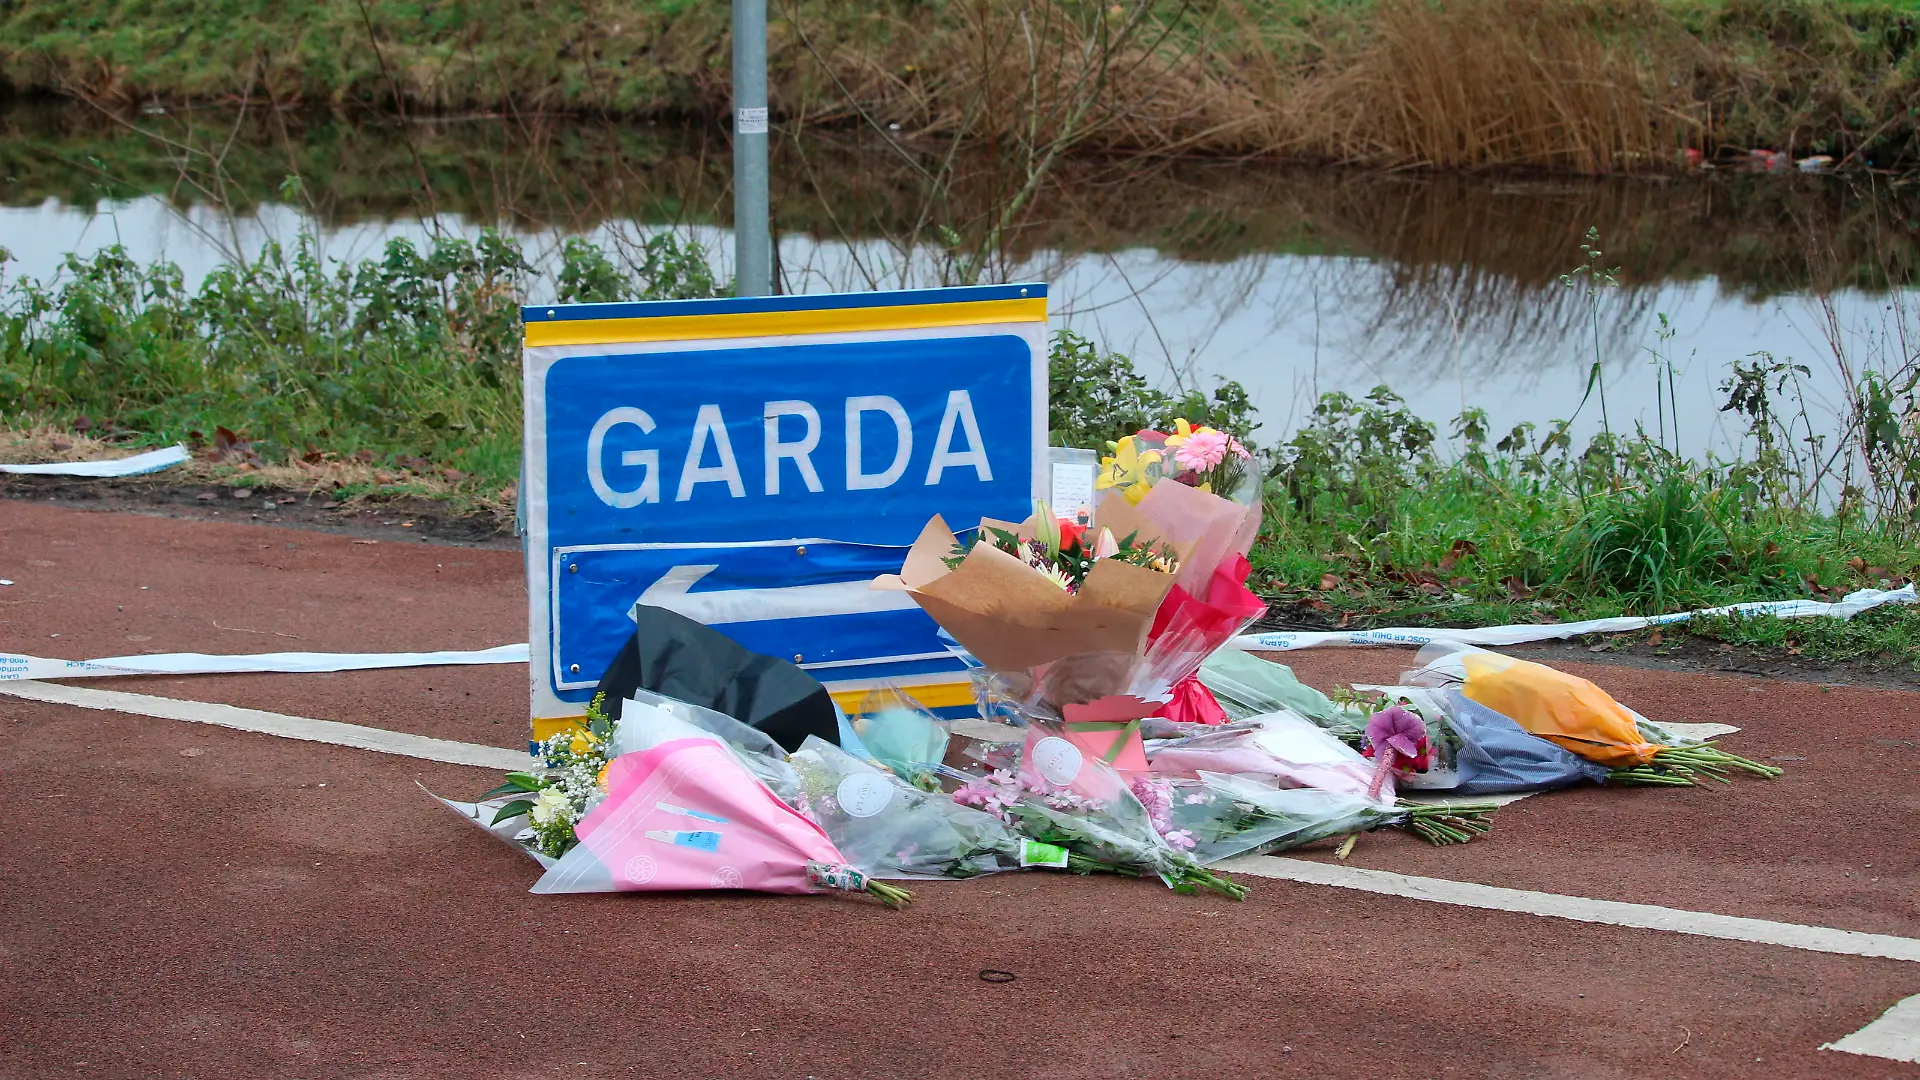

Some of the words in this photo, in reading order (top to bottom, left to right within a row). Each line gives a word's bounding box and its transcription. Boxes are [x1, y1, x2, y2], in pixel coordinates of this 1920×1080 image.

[586, 389, 993, 508] GARDA
[1259, 639, 1290, 648] GARDA
[1408, 635, 1431, 643] COSC
